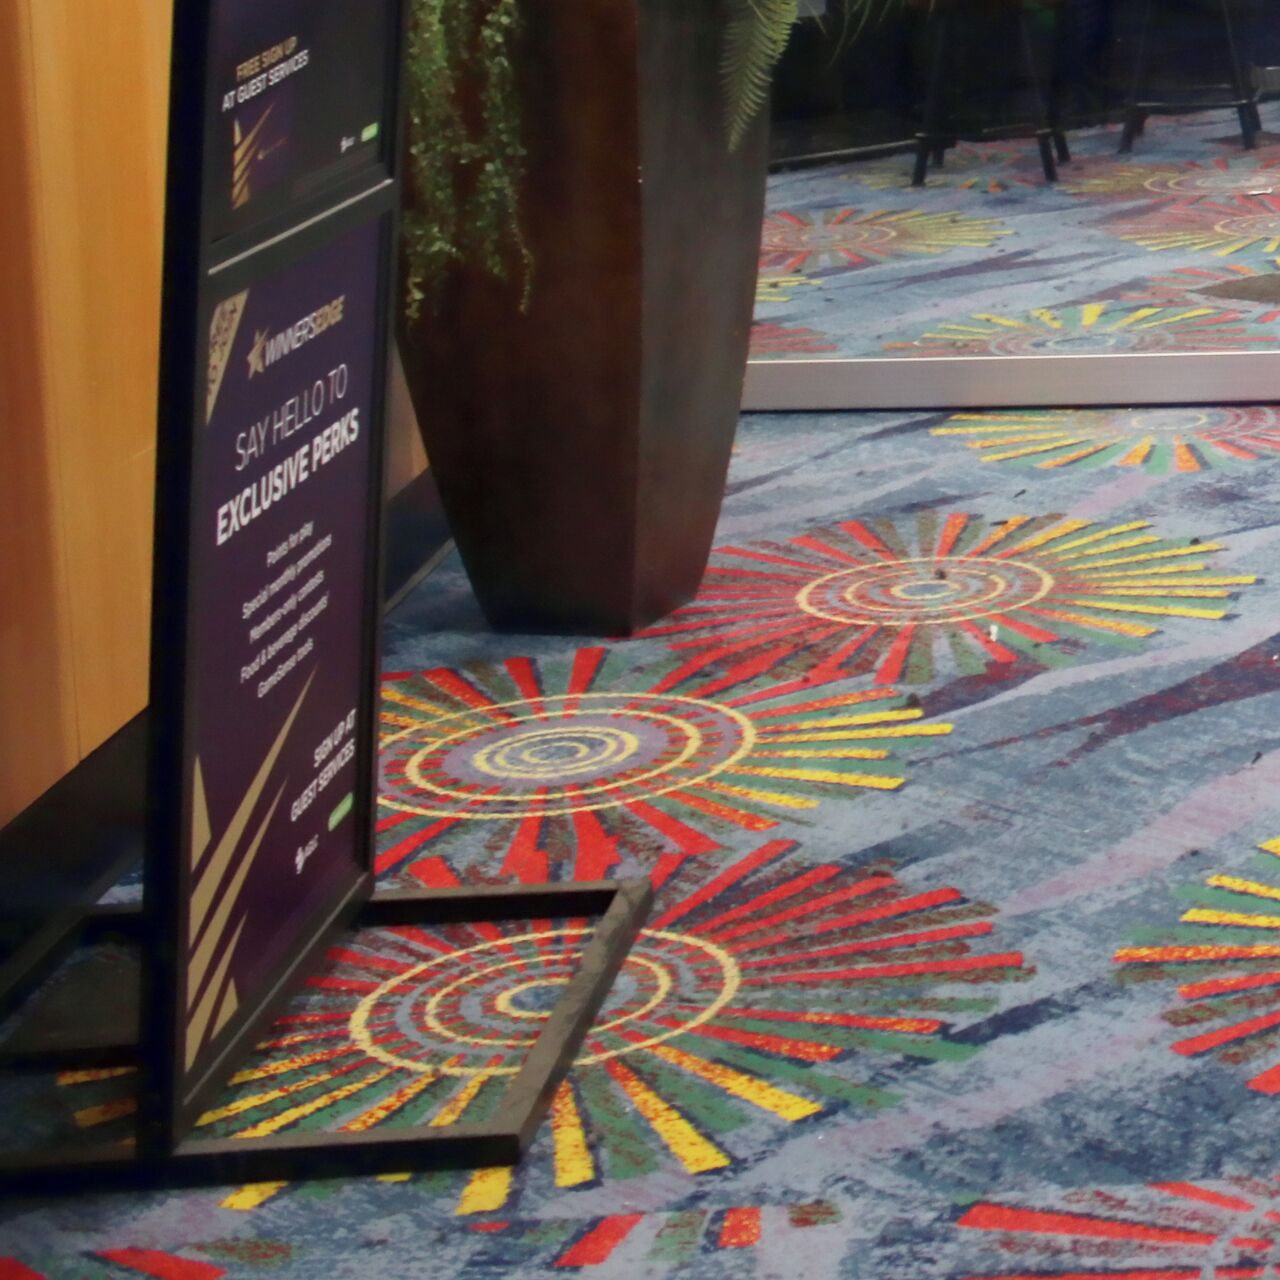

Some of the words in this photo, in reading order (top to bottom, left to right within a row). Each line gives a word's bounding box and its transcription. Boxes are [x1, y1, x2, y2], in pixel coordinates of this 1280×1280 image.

[222, 89, 236, 113] AT
[236, 72, 267, 104] GUEST
[267, 48, 310, 87] SERVICES
[235, 53, 261, 82] FREE
[261, 41, 284, 70] SIGN
[284, 35, 297, 56] UP
[234, 416, 270, 472] SAY
[272, 379, 325, 447] HELLO
[327, 362, 348, 405] TO
[215, 443, 310, 547] EXCLUSIVE
[311, 407, 360, 473] PERKS
[266, 541, 289, 568] Points
[314, 730, 334, 768] SIGN
[333, 719, 346, 746] UP
[345, 707, 357, 734] AT
[290, 777, 318, 823] GUEST
[317, 737, 356, 792] SERVICES
